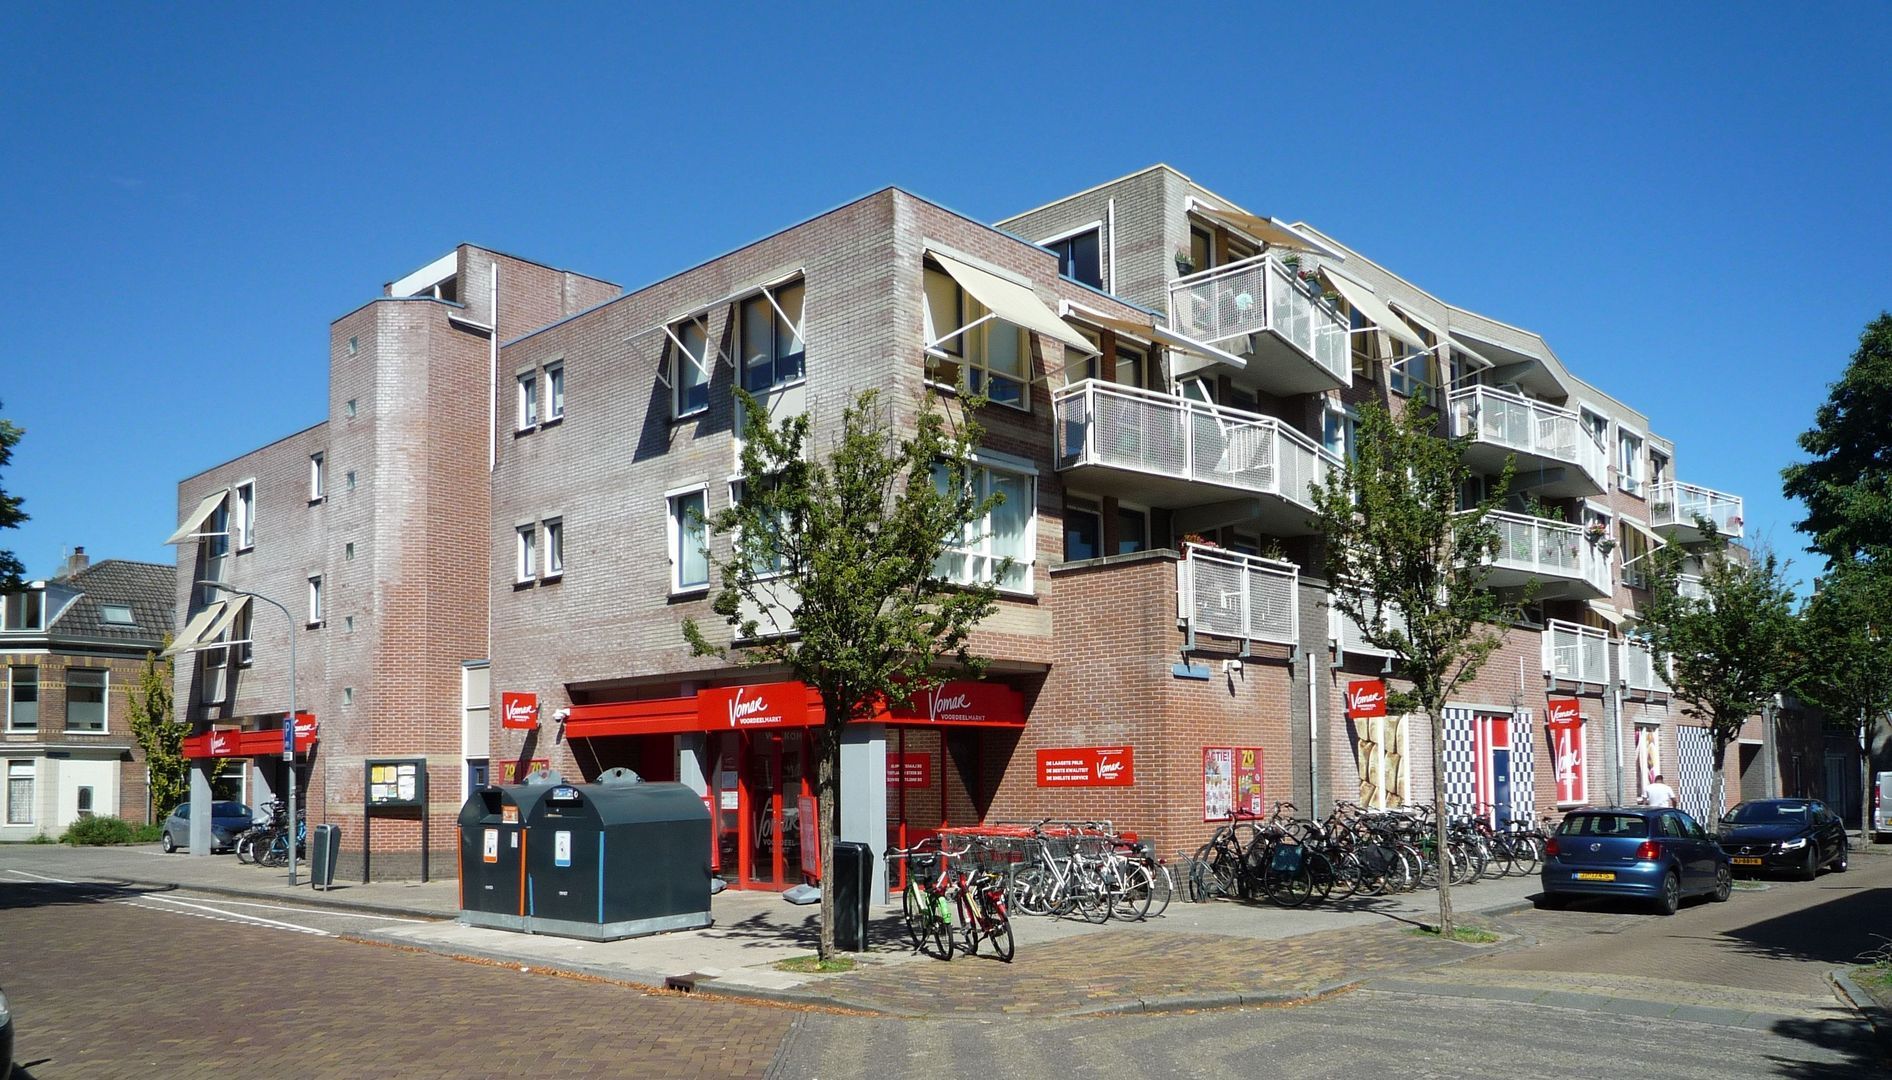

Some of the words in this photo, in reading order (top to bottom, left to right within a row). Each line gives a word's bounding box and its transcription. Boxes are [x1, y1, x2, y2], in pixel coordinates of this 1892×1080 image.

[729, 688, 768, 727] Vomar
[929, 683, 971, 721] Vomar
[1351, 688, 1383, 710] Vomar
[506, 700, 536, 720] Vomar
[740, 716, 782, 725] VOORDEELMARKT
[1550, 706, 1578, 723] Vomar
[1206, 751, 1230, 762] ACTIE!
[1096, 756, 1124, 779] Vomar
